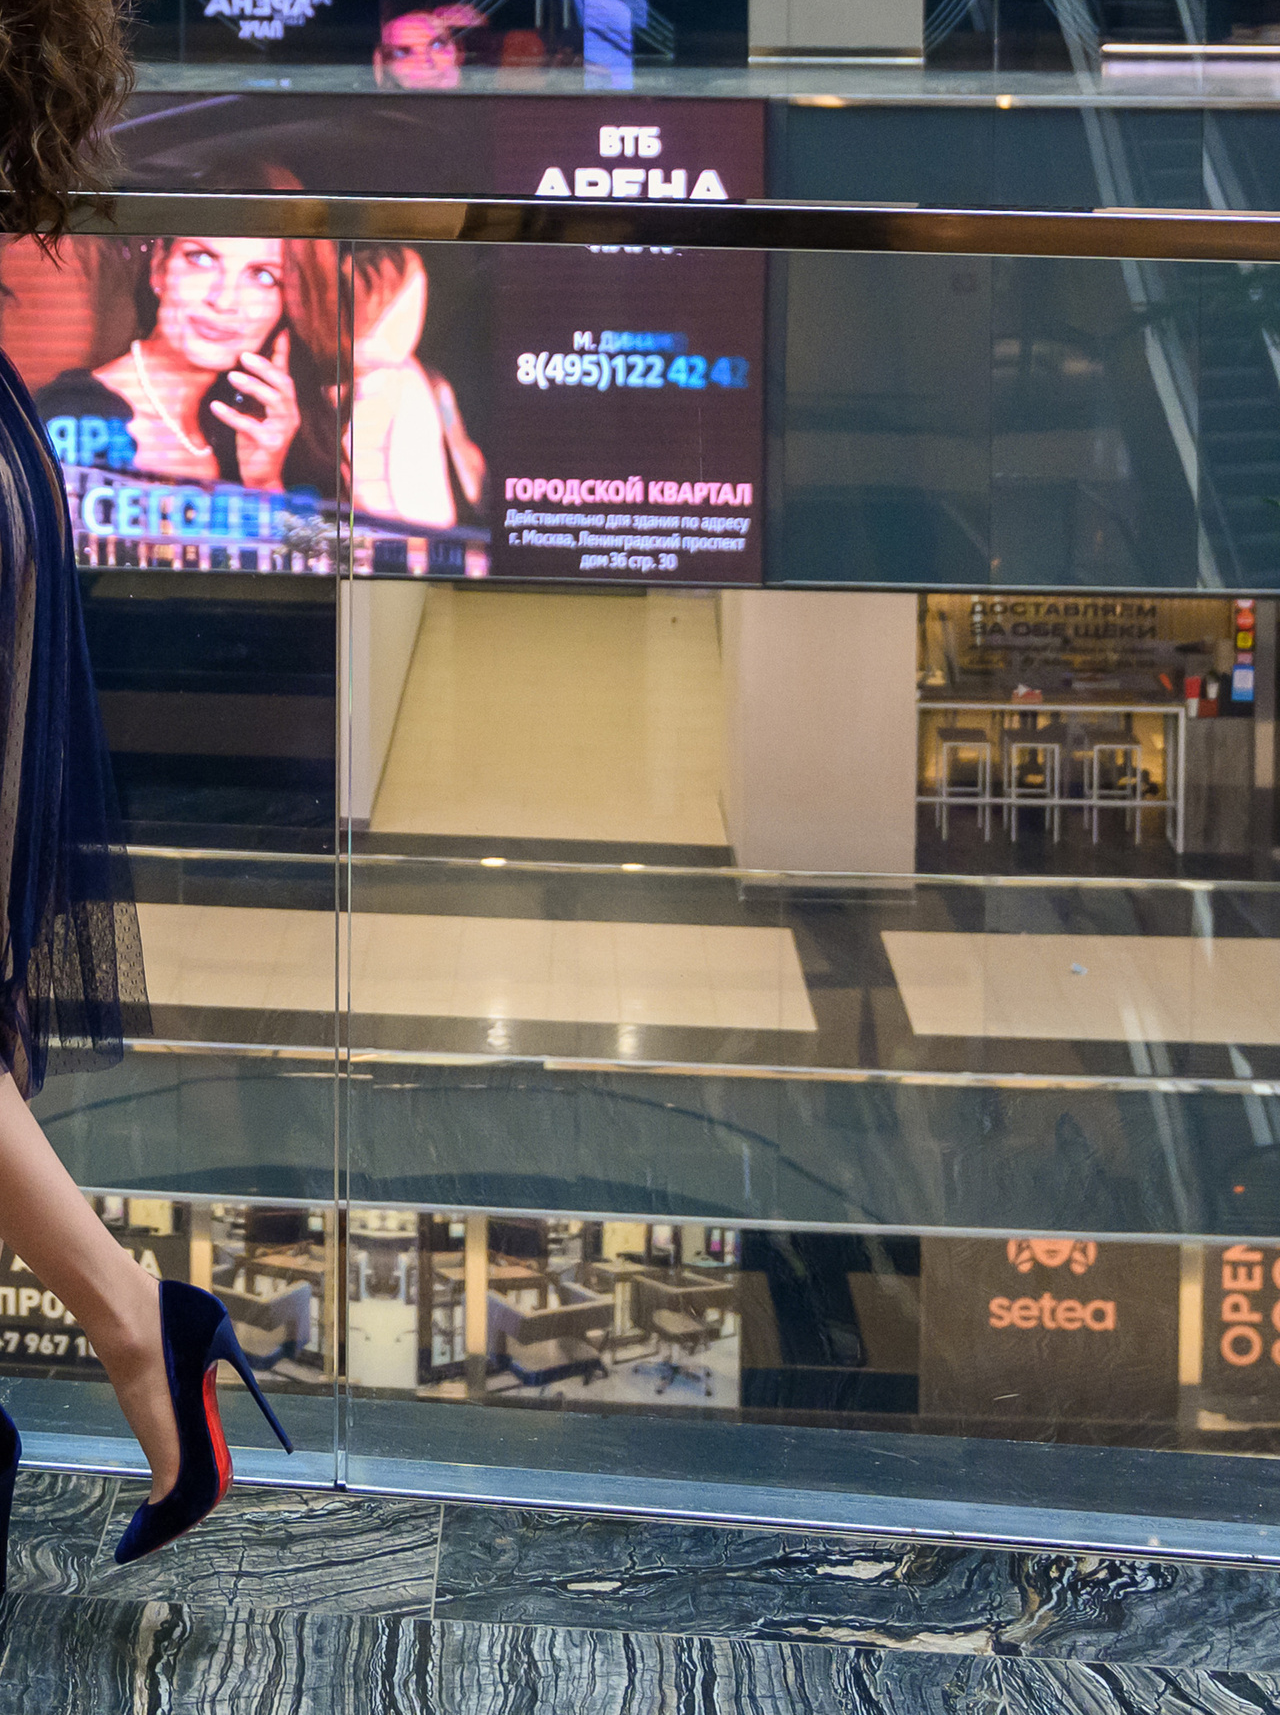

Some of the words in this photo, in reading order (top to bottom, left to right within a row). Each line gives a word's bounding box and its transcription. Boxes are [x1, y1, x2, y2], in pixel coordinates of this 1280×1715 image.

[599, 125, 662, 158] ВТБ
[517, 351, 666, 391] 8(495)122
[667, 354, 708, 390] 42
[505, 475, 644, 506] ГОРОДСКОЙ
[648, 481, 753, 506] КВАРТАЛ
[505, 508, 605, 528] Действительно
[605, 514, 632, 530] для
[632, 514, 680, 531] здания
[681, 516, 700, 531] по
[701, 516, 751, 535] адресу
[509, 532, 521, 545] г.
[578, 530, 680, 552] Ленинградский
[681, 536, 746, 554] проспект
[579, 554, 609, 570] дом
[628, 555, 658, 573] стр.
[658, 552, 679, 571] 30
[988, 1292, 1117, 1331] setea
[24, 1332, 70, 1356] 967
